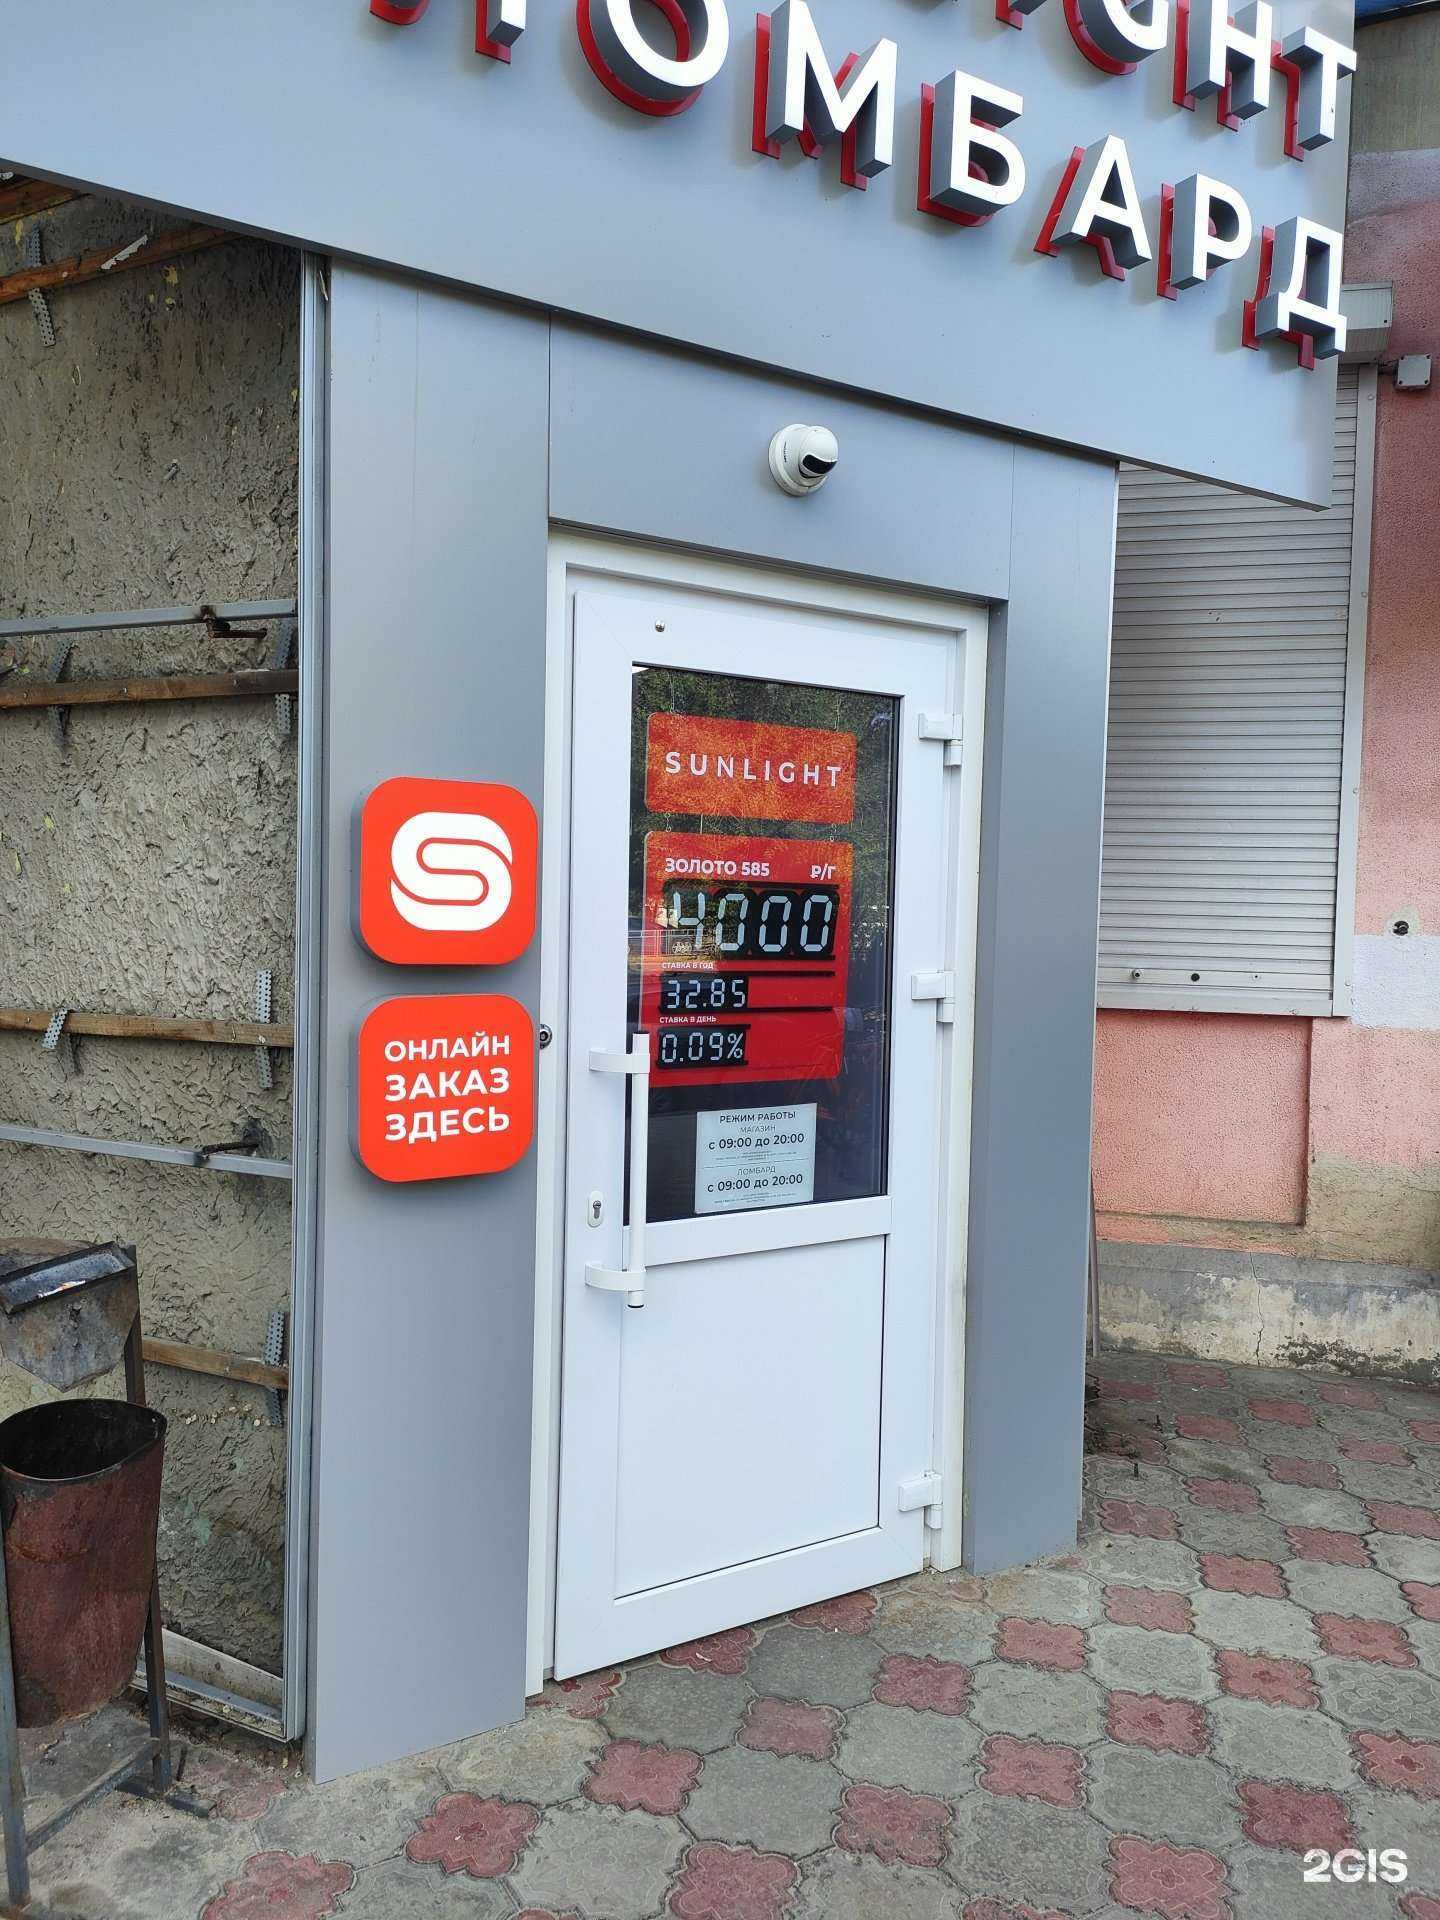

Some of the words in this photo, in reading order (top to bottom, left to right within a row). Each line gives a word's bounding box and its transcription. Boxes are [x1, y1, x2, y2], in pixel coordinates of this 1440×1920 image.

[372, 0, 1347, 366] ОМБАРД
[665, 751, 842, 787] SUNLIGHT
[664, 857, 737, 876] ЗОЛОТО
[741, 861, 770, 877] 585
[673, 891, 833, 953] 4000
[662, 962, 691, 970] СТАВКА
[692, 962, 698, 970] В
[699, 962, 714, 970] ГОД
[666, 978, 746, 1009] 32.85
[659, 1016, 689, 1024] СТАВКА
[696, 1015, 717, 1024] ДЕНЬ
[384, 1031, 511, 1063] ОНЛАЙН
[661, 1031, 743, 1063] 0.09%
[384, 1067, 511, 1102] ЗАКАЗ
[384, 1105, 511, 1145] ЗДЕСЬ
[719, 1113, 755, 1124] РЕЖИМ
[757, 1111, 796, 1122] РАБОТЫ
[740, 1125, 776, 1133] МАГАЗИН
[708, 1141, 715, 1150] с
[718, 1137, 752, 1149] 09:00
[755, 1138, 770, 1148] до
[773, 1133, 805, 1145] 20:00
[737, 1165, 776, 1176] ЛОМБАРД
[707, 1184, 714, 1193] с
[717, 1179, 751, 1192] 09:00
[753, 1179, 769, 1190] до
[772, 1174, 803, 1186] 20:00
